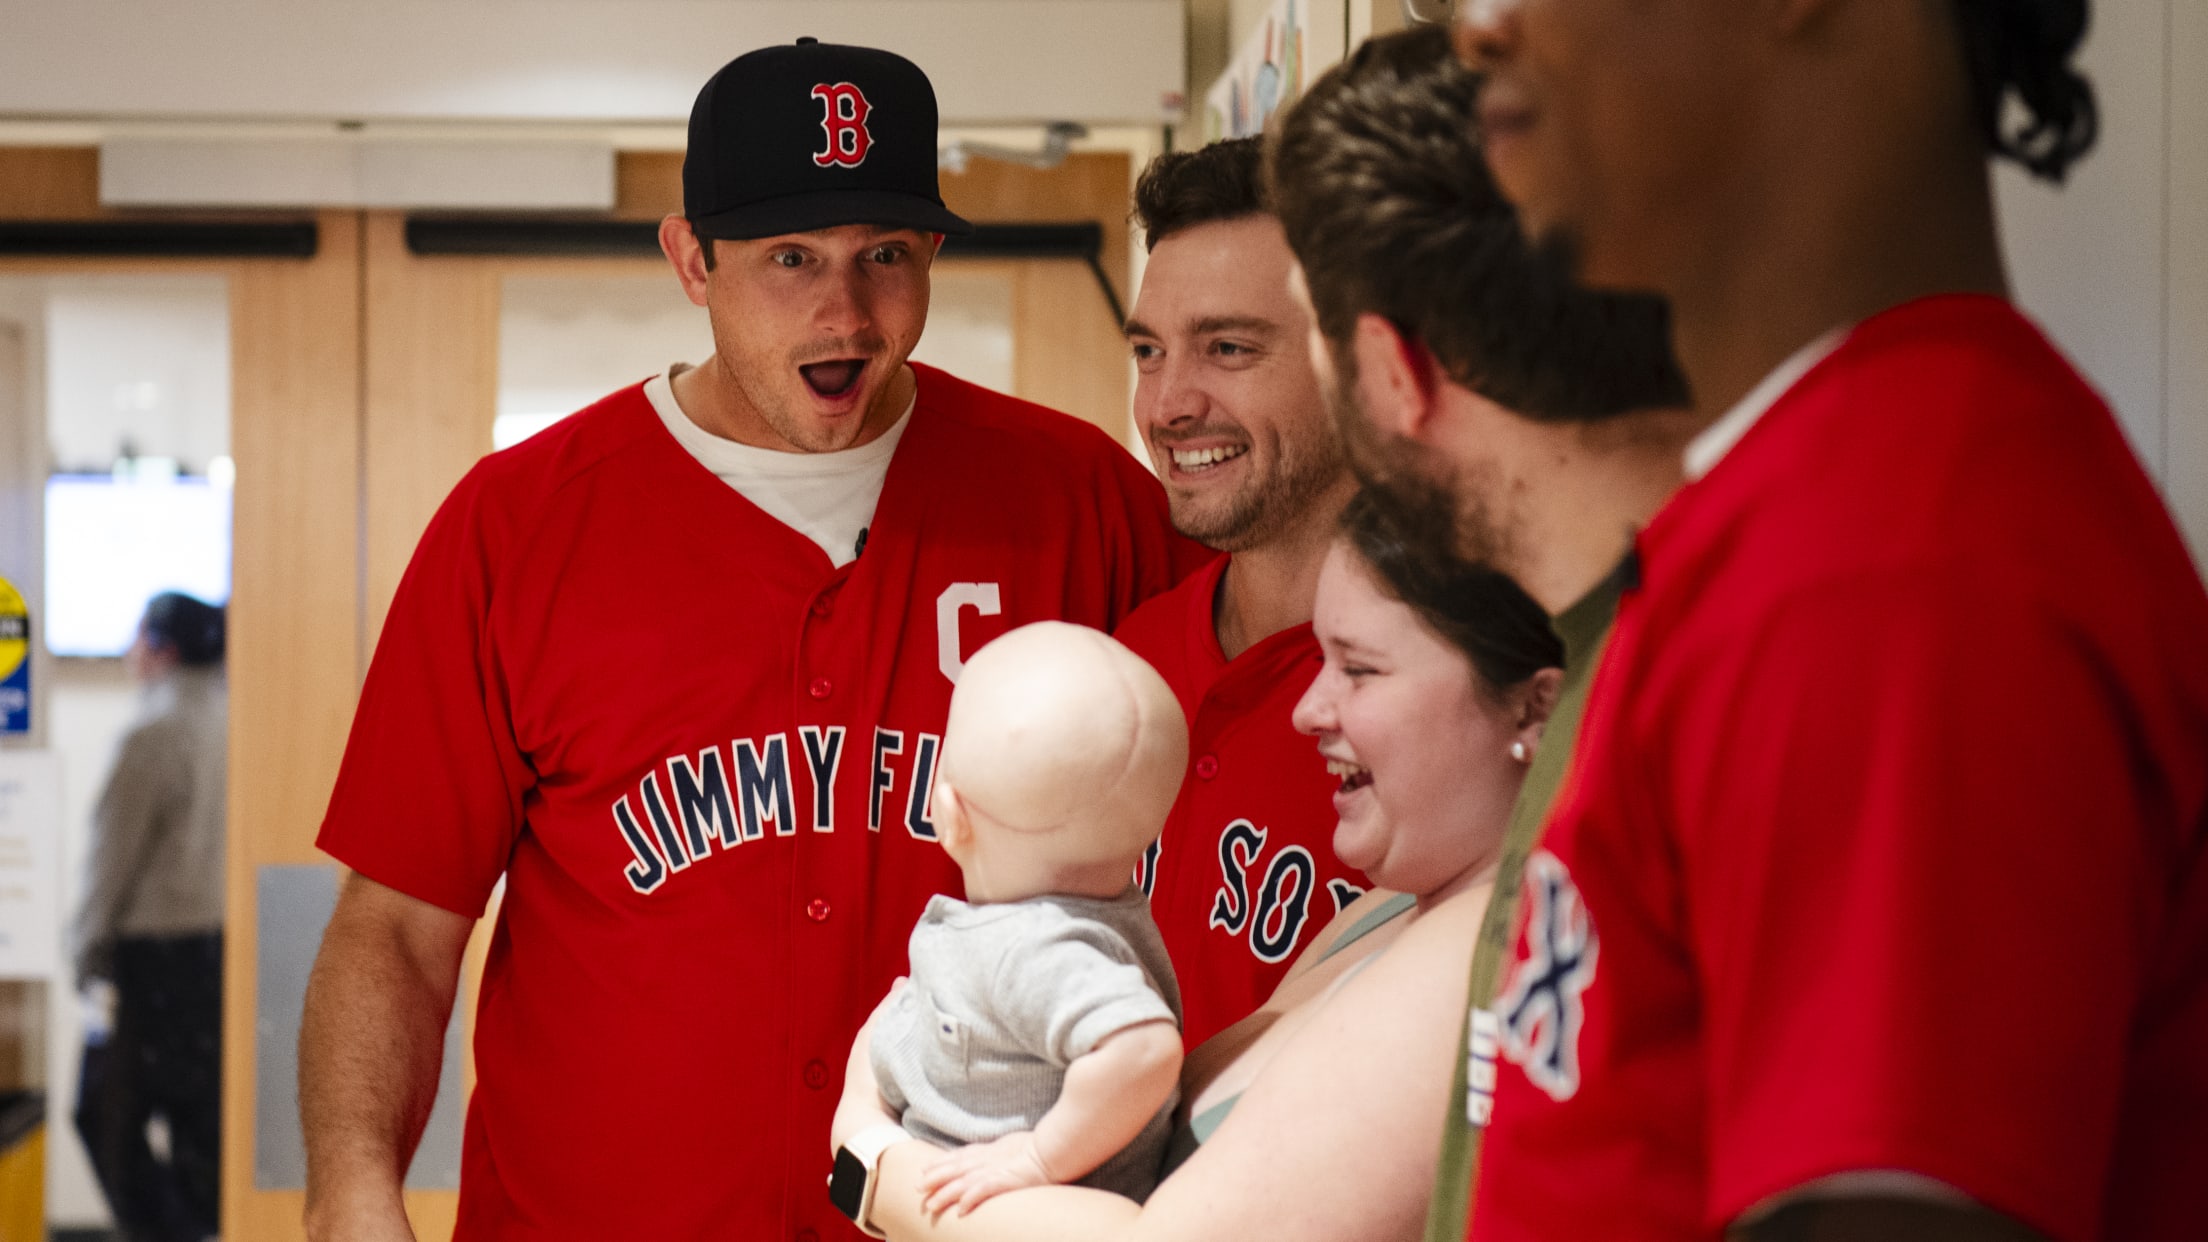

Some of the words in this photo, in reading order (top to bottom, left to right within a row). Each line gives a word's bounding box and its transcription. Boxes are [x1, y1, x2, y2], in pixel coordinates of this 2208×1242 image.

[810, 81, 875, 169] B
[936, 581, 1002, 686] C
[611, 725, 847, 895] JIMMY
[1209, 818, 1368, 964] SO
